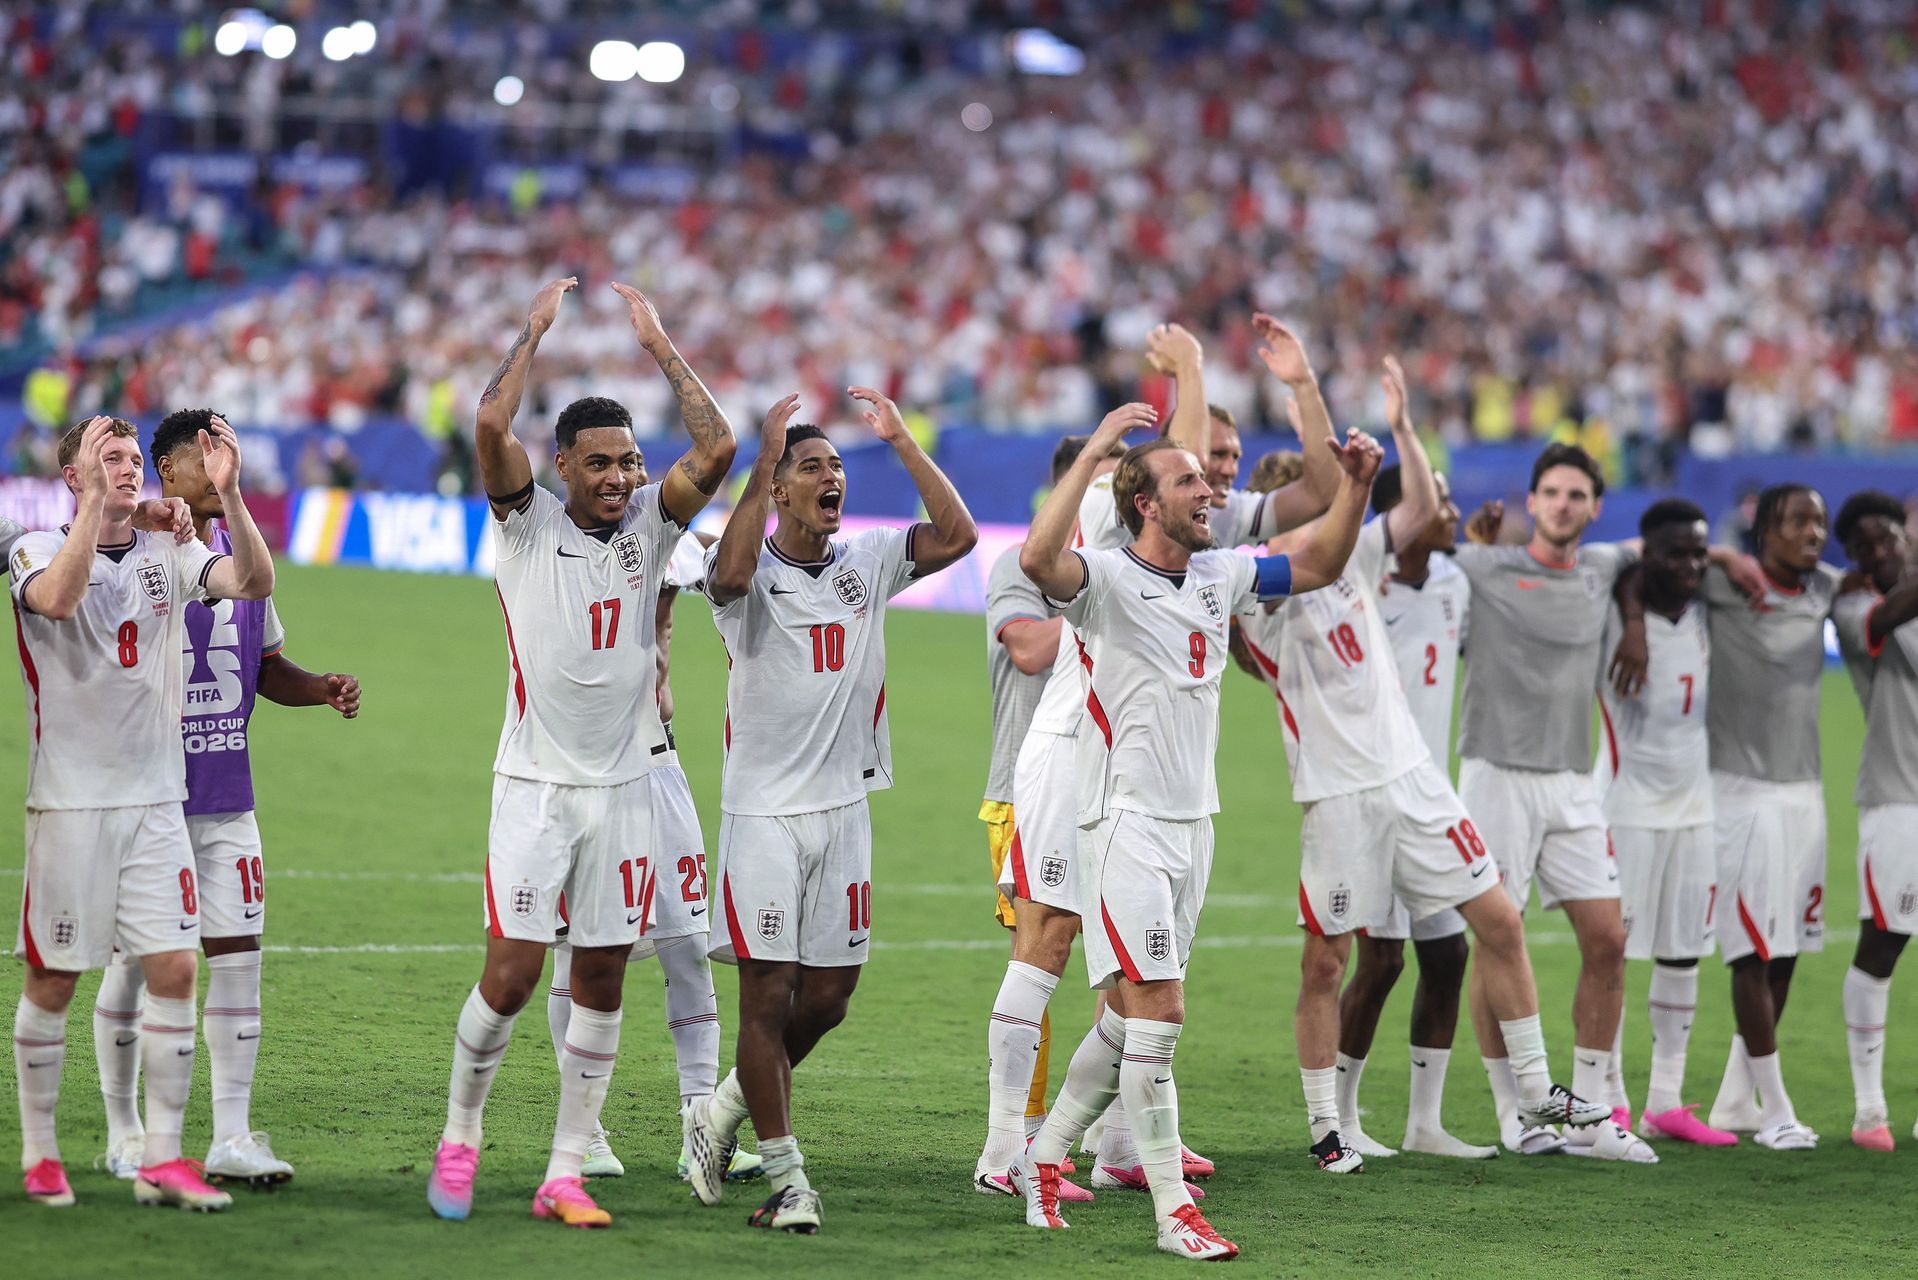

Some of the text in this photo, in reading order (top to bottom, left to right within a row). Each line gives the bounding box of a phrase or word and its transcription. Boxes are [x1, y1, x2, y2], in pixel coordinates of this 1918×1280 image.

[118, 620, 138, 668] 8
[589, 597, 621, 650] 17
[1328, 622, 1364, 668] 18
[809, 623, 845, 673] 10
[1188, 631, 1206, 678] 9
[1424, 643, 1437, 686] 2
[187, 688, 223, 704] FIFA
[1679, 673, 1693, 716] 7
[181, 718, 245, 734] ORLD CUP
[183, 732, 246, 754] 026
[1446, 818, 1486, 865] 18
[179, 867, 197, 915] 8
[236, 856, 264, 904] 19
[619, 856, 648, 908] 17
[677, 854, 707, 902] 25
[846, 881, 870, 931] 10
[1803, 884, 1824, 925] 2
